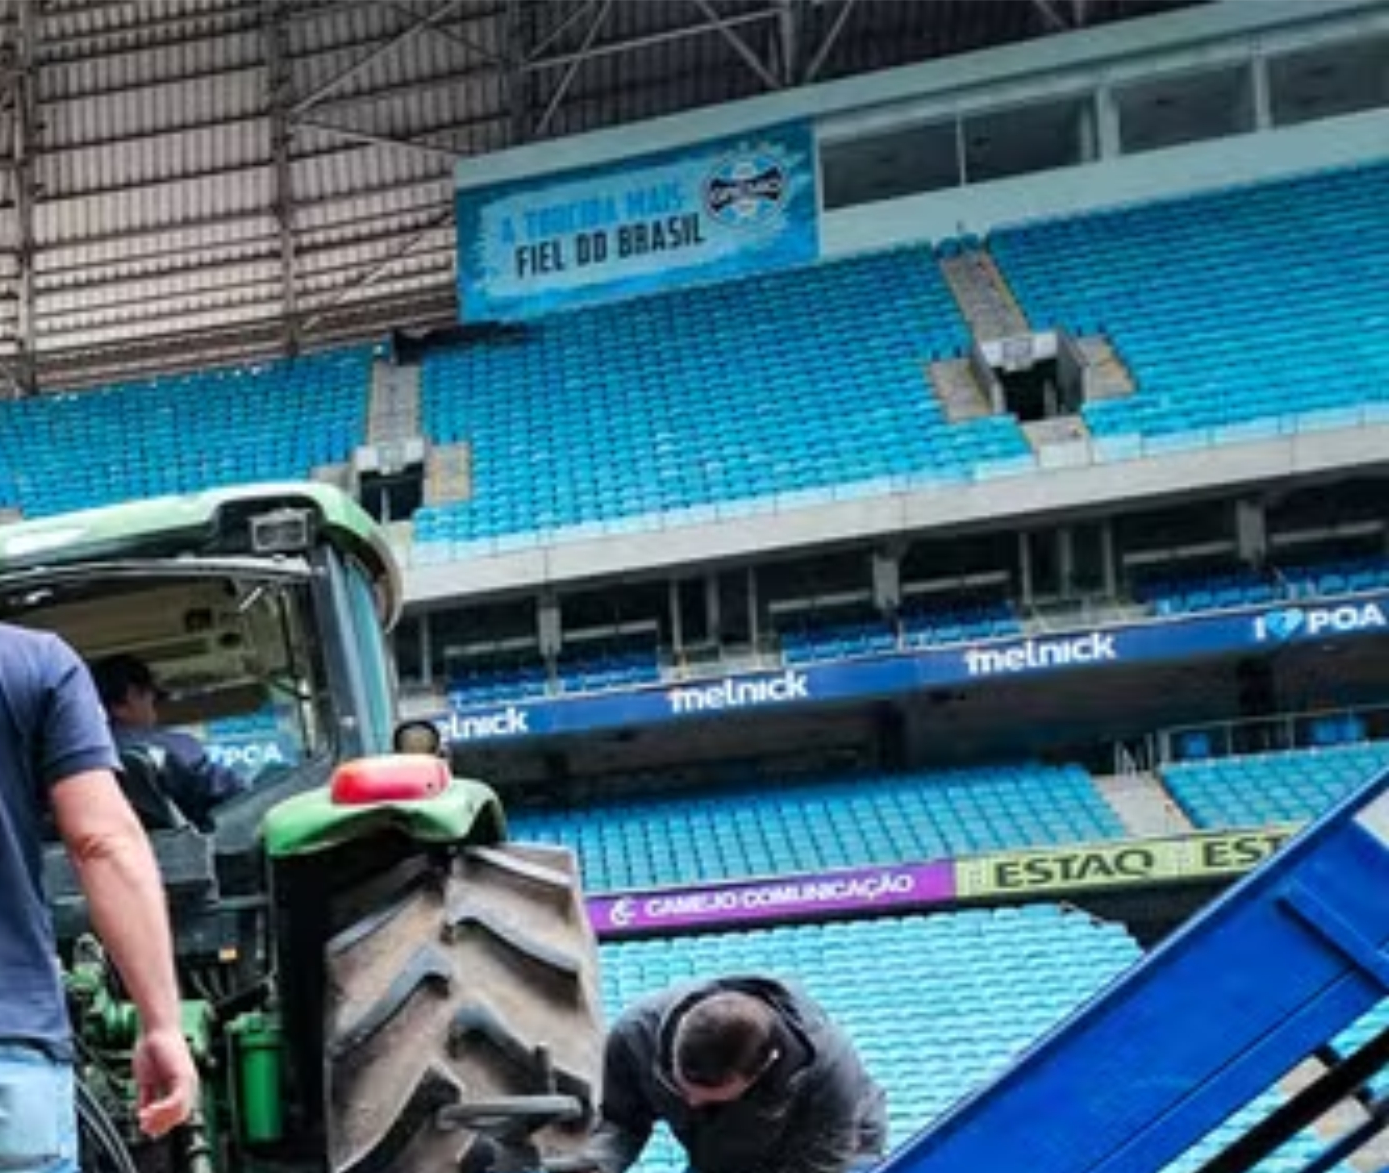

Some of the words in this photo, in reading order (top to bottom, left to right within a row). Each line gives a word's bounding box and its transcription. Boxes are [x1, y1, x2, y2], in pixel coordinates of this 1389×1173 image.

[515, 242, 565, 279] FIEL
[577, 229, 608, 267] DO
[618, 213, 706, 259] BRASIL
[1308, 603, 1389, 635] POA
[962, 632, 1118, 676] melnick
[667, 670, 808, 714] melnick
[435, 707, 530, 744] elnick
[994, 848, 1155, 889] ESTAQ
[1201, 835, 1288, 869] EST
[743, 871, 915, 909] COMUNICAÇÃO
